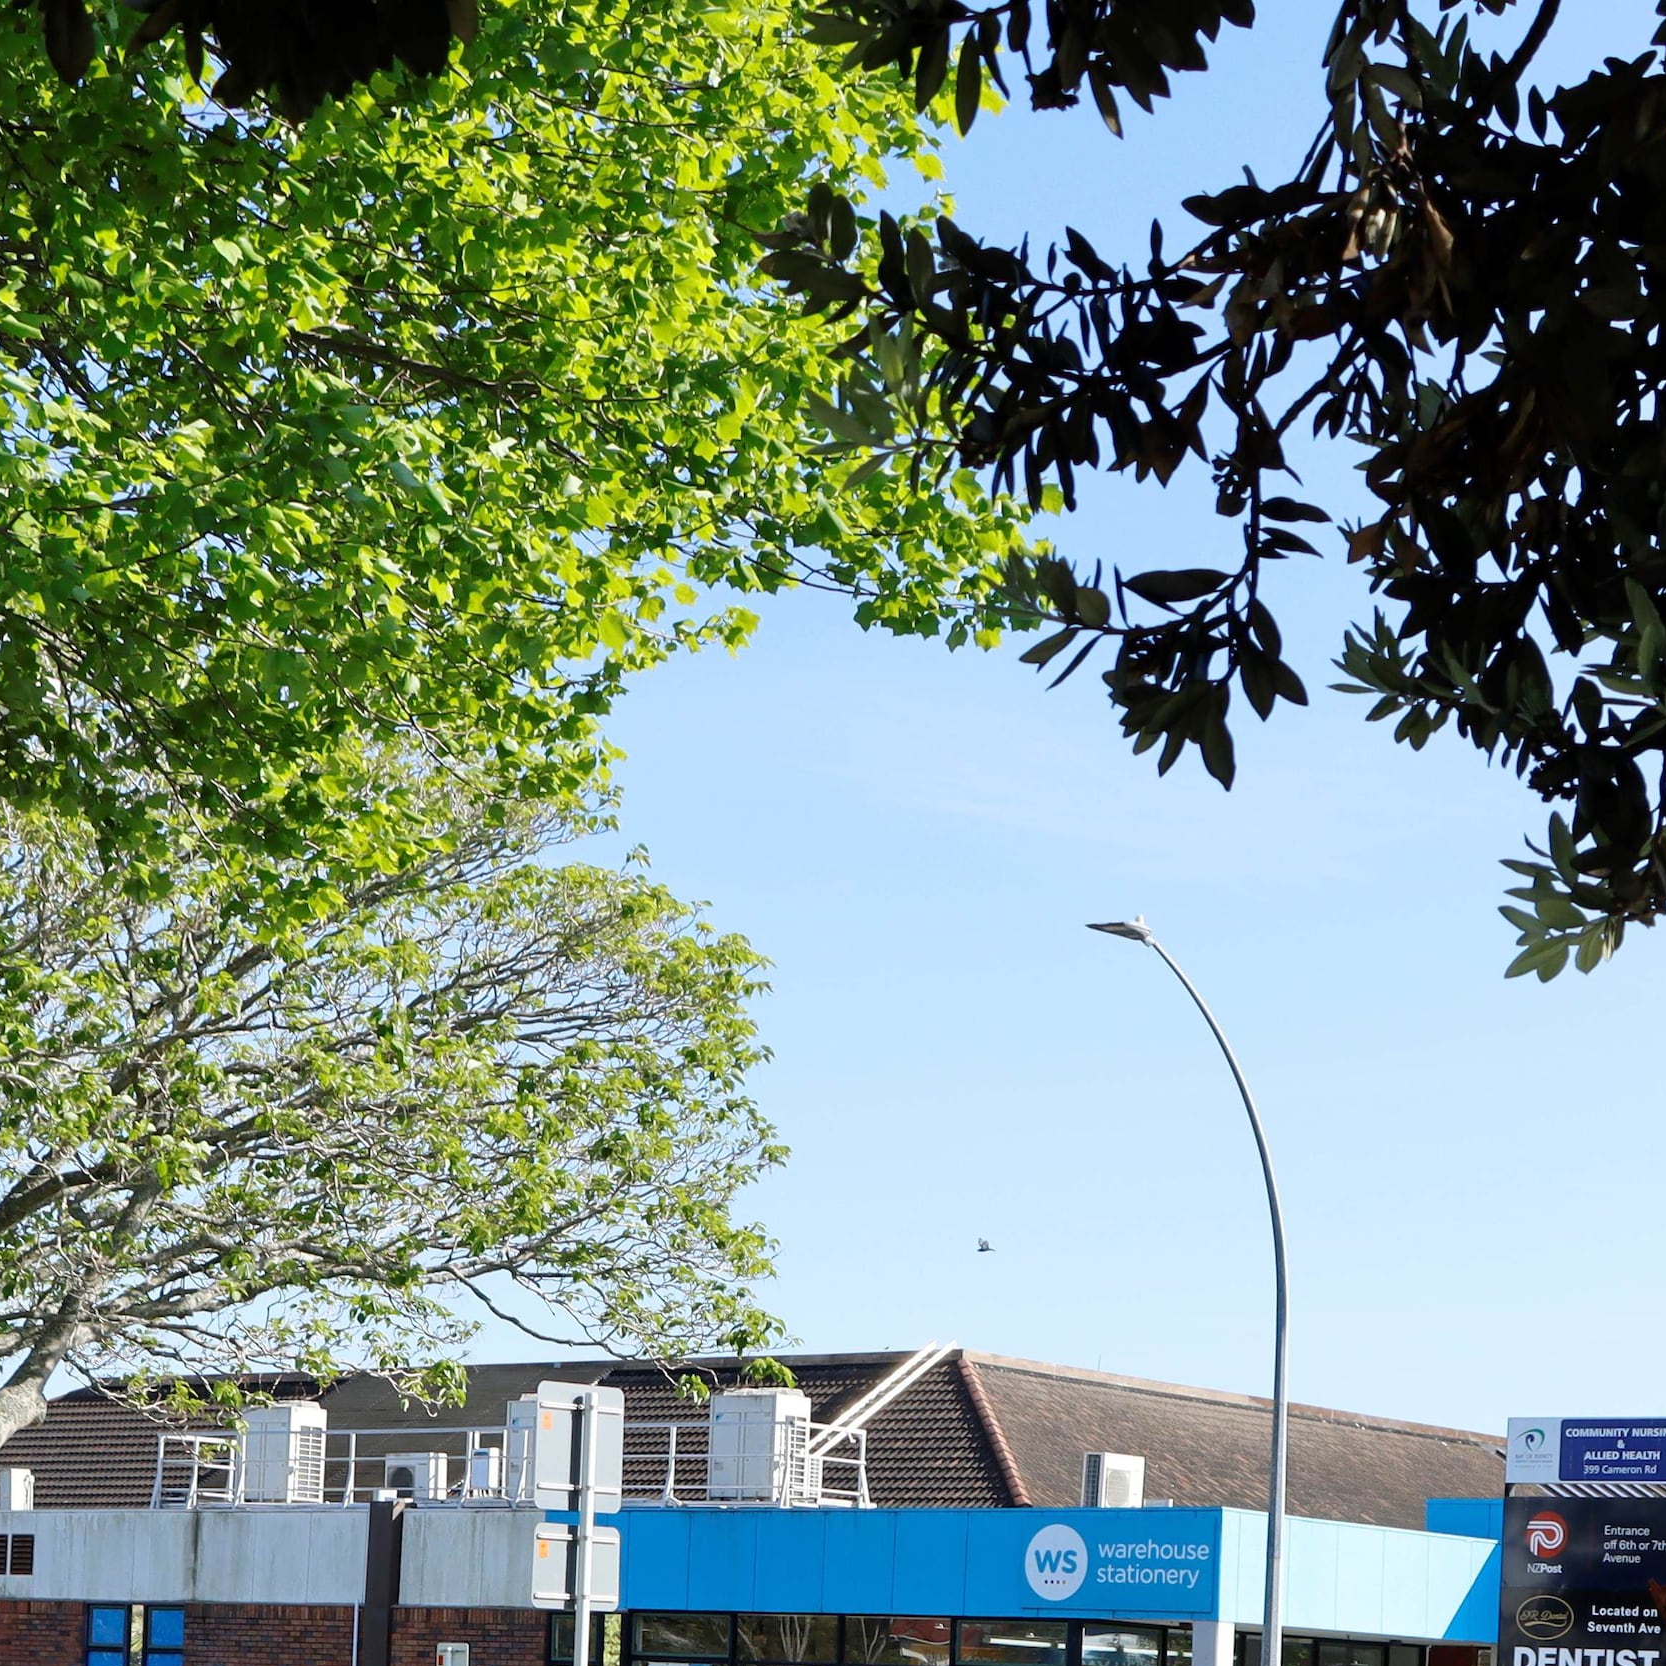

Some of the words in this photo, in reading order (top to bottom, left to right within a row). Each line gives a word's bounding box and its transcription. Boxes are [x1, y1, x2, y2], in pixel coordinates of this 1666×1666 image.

[1565, 1427, 1630, 1438] COMMUNITY
[1616, 1439, 1626, 1449] &
[1583, 1450, 1620, 1461] ALLIED
[1622, 1450, 1661, 1461] HEALTH
[1583, 1464, 1600, 1475] 399
[1601, 1464, 1643, 1475] Cameron
[1644, 1464, 1657, 1474] Rd
[1604, 1524, 1651, 1537] Entrance
[1097, 1538, 1210, 1561] warehouse
[1603, 1539, 1618, 1550] off
[1618, 1540, 1637, 1551] 6th
[1638, 1542, 1650, 1551] or
[1035, 1549, 1078, 1575] WS
[1602, 1553, 1642, 1564] Avenue
[1526, 1563, 1563, 1574] NZPost
[1096, 1563, 1200, 1589] stationery
[1591, 1605, 1639, 1618] Located
[1642, 1608, 1658, 1618] on
[1587, 1620, 1636, 1634] Seventh
[1638, 1622, 1662, 1634] Ave
